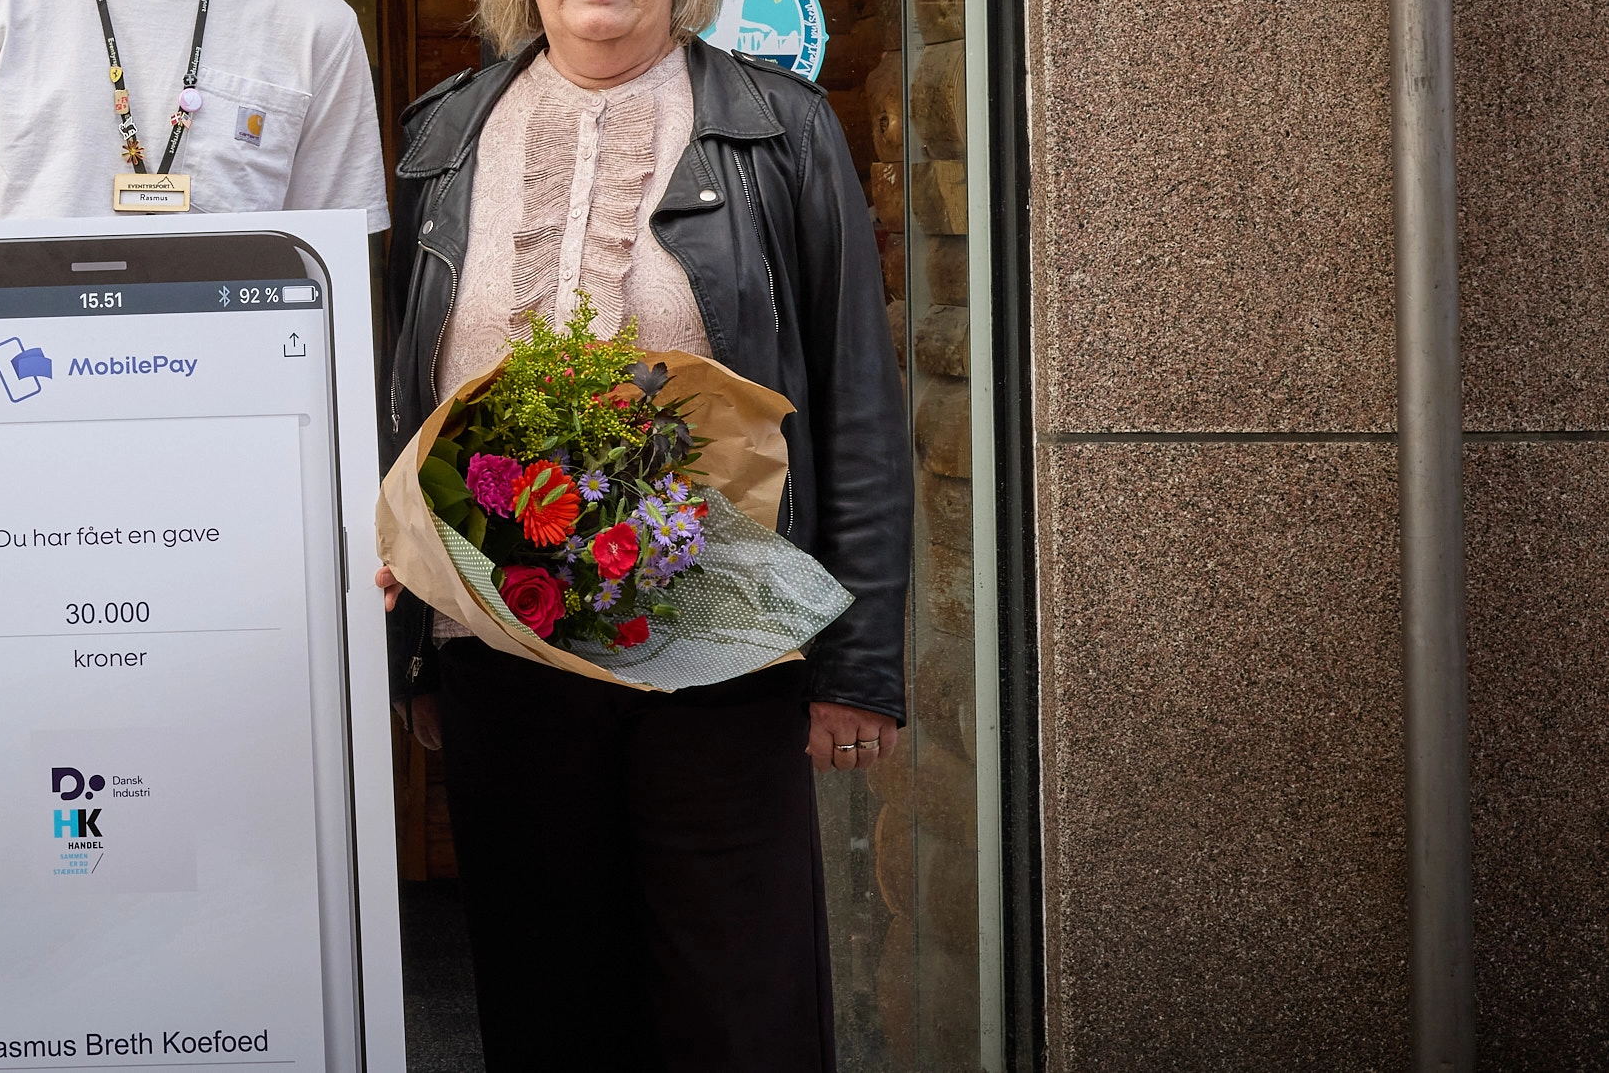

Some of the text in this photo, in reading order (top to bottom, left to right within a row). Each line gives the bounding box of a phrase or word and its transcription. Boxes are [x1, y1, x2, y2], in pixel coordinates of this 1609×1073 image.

[169, 124, 184, 155] ntyrsport
[139, 193, 168, 201] Rasmus
[79, 292, 123, 310] 15.51
[239, 287, 260, 304] 92
[264, 287, 280, 304] %
[68, 354, 198, 378] MobilePay
[33, 528, 72, 547] har
[77, 526, 122, 546] fået
[128, 529, 157, 544] en
[162, 528, 220, 548] gave
[65, 601, 150, 625] 30.000
[74, 649, 148, 668] kroner
[112, 775, 143, 786] Dansk
[112, 788, 150, 798] Industri
[53, 808, 103, 838] HK
[68, 841, 104, 850] HANDEL
[85, 1032, 153, 1056] Breth
[162, 1029, 269, 1054] Koefoed
